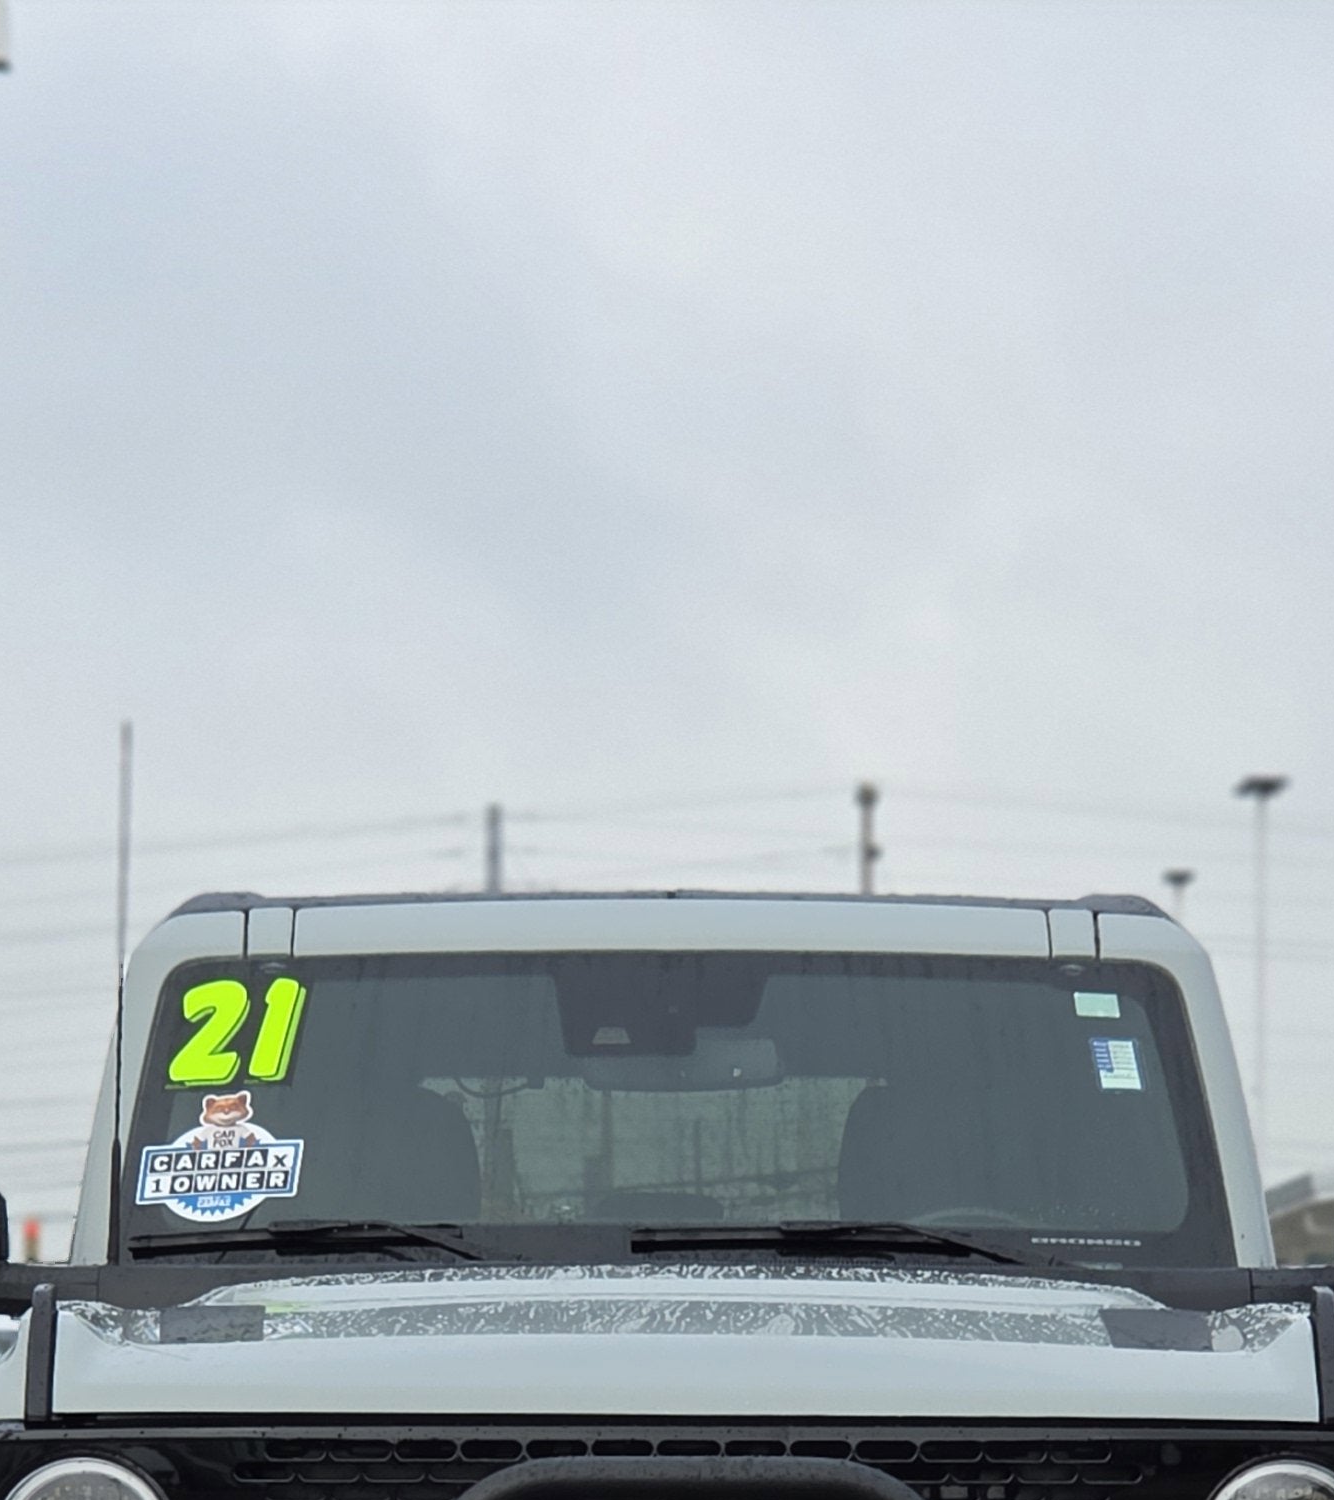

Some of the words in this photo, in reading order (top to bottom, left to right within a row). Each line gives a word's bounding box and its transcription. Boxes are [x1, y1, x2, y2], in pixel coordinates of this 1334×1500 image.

[168, 977, 306, 1086] 21
[213, 1130, 235, 1140] CAR
[213, 1138, 234, 1149] FOX
[153, 1150, 288, 1172] CARFAX
[151, 1178, 164, 1194] 1
[173, 1172, 286, 1193] OWNER
